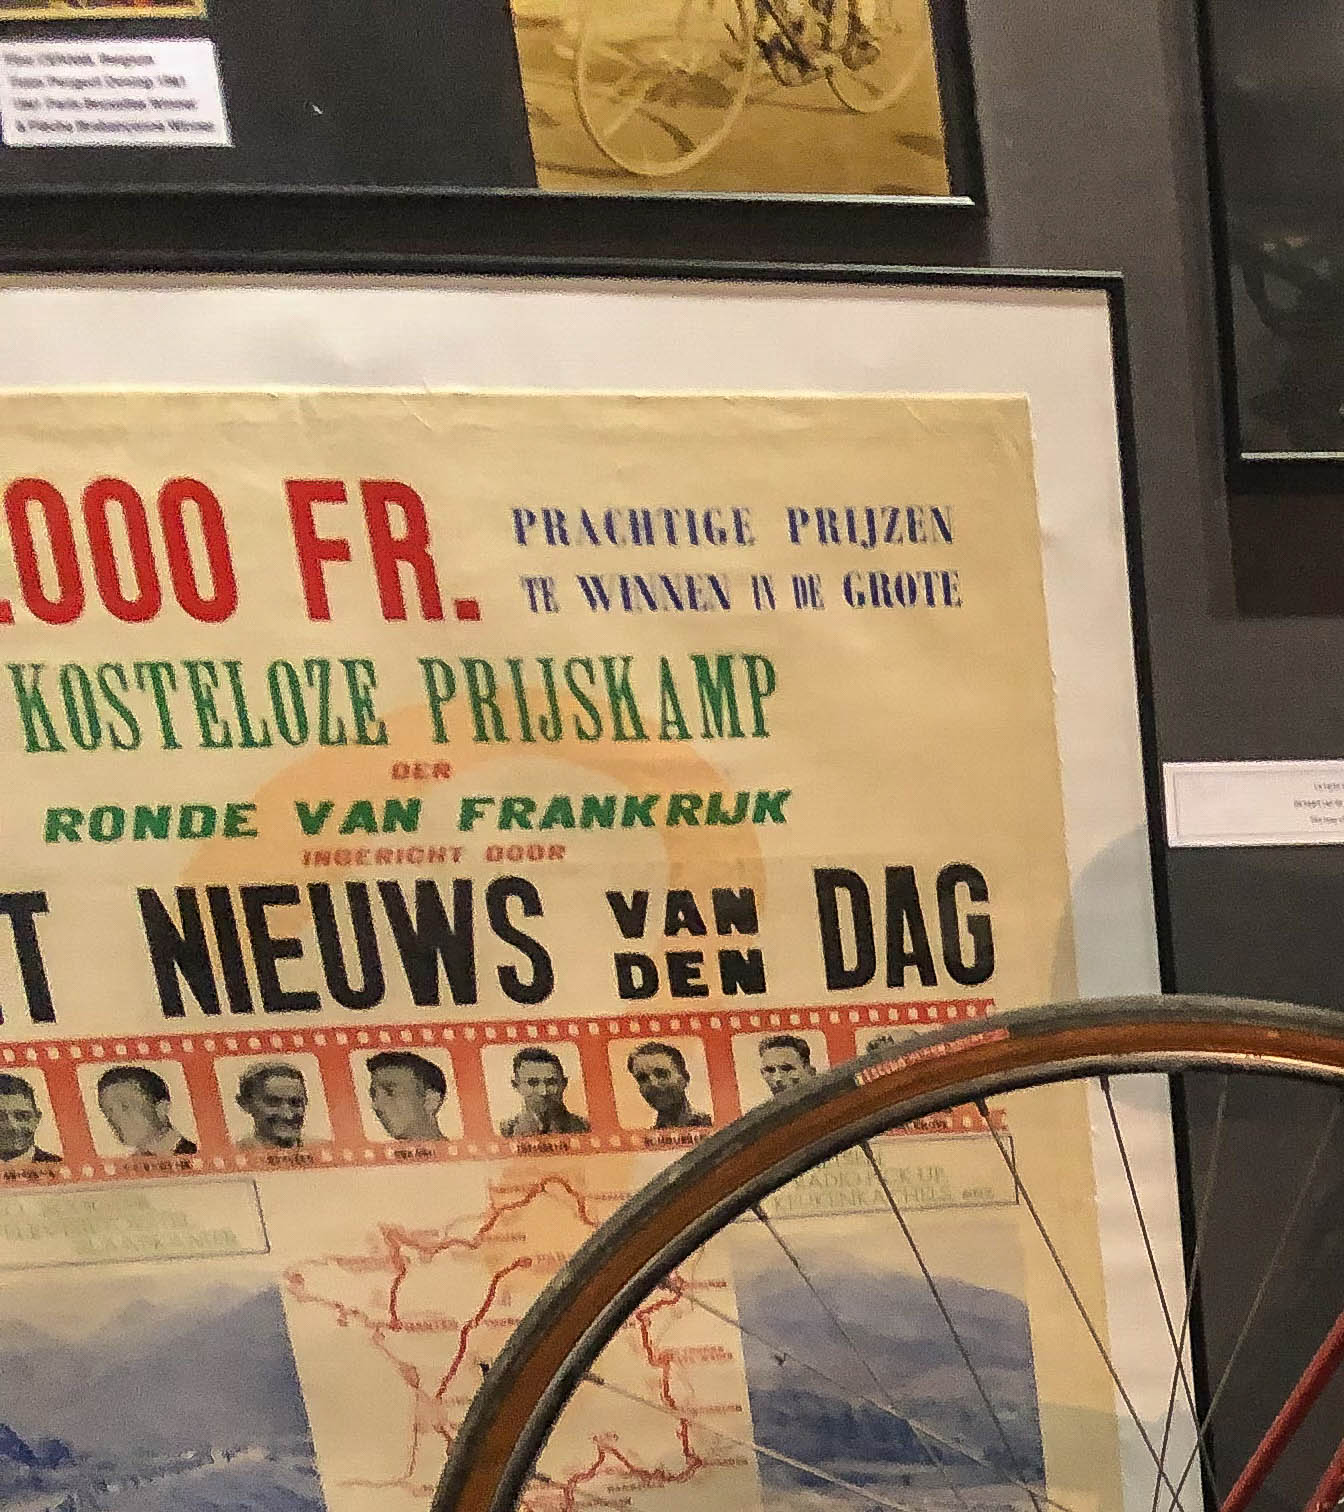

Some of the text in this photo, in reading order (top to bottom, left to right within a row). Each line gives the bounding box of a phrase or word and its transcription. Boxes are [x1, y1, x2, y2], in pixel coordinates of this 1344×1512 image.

[284, 478, 483, 623] FR.
[510, 503, 957, 550] PRACHTIGE PRIJZEN
[520, 569, 963, 613] TE WINNEN IN DE GROTE
[7, 652, 778, 754] KOSTELOZE PRIJSKAMP
[45, 788, 792, 843] RONDE VAN FRANKRIJK
[485, 843, 566, 863] DOOR
[604, 886, 761, 940] VAN
[813, 862, 996, 993] DAG
[136, 874, 556, 1019] NIEUWS
[613, 948, 767, 1000] DEN
